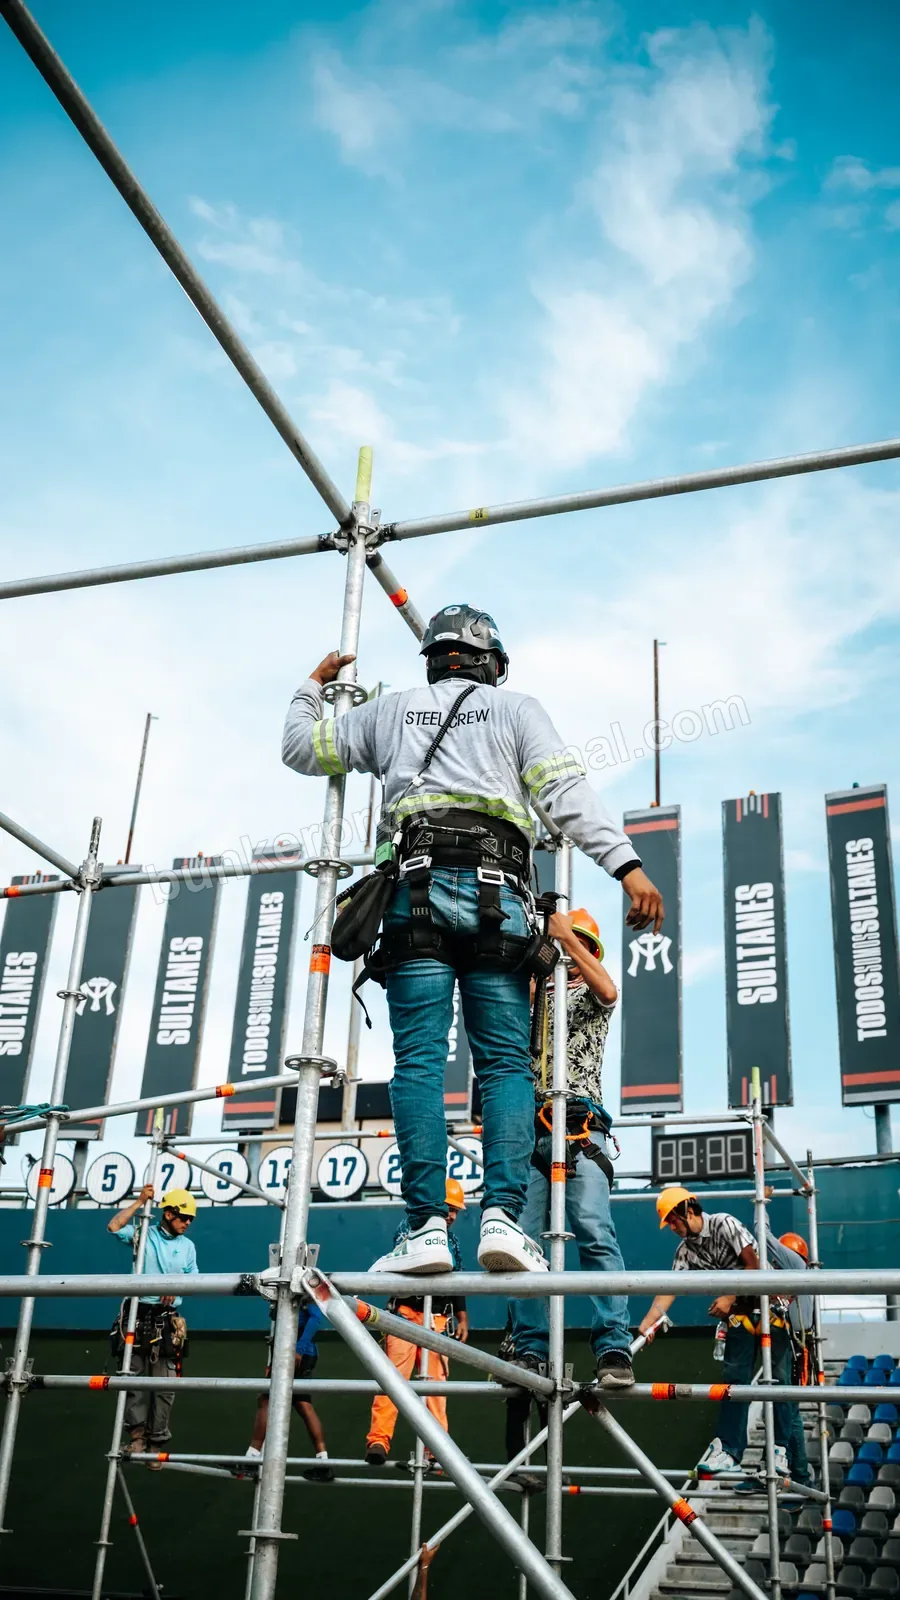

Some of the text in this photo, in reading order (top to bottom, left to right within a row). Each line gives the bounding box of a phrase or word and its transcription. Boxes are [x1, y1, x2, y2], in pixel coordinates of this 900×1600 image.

[405, 708, 490, 728] STEEL CREW
[537, 943, 556, 965] JBL
[735, 882, 778, 1006] SULTANES
[0, 952, 38, 1056] SULTANES
[156, 936, 204, 1046] SULTANES
[101, 1164, 118, 1192] 5
[161, 1163, 175, 1191] 7
[326, 1156, 358, 1186] 17
[449, 1150, 482, 1180] 21
[425, 1237, 447, 1246] adid
[481, 1226, 508, 1237] didas
